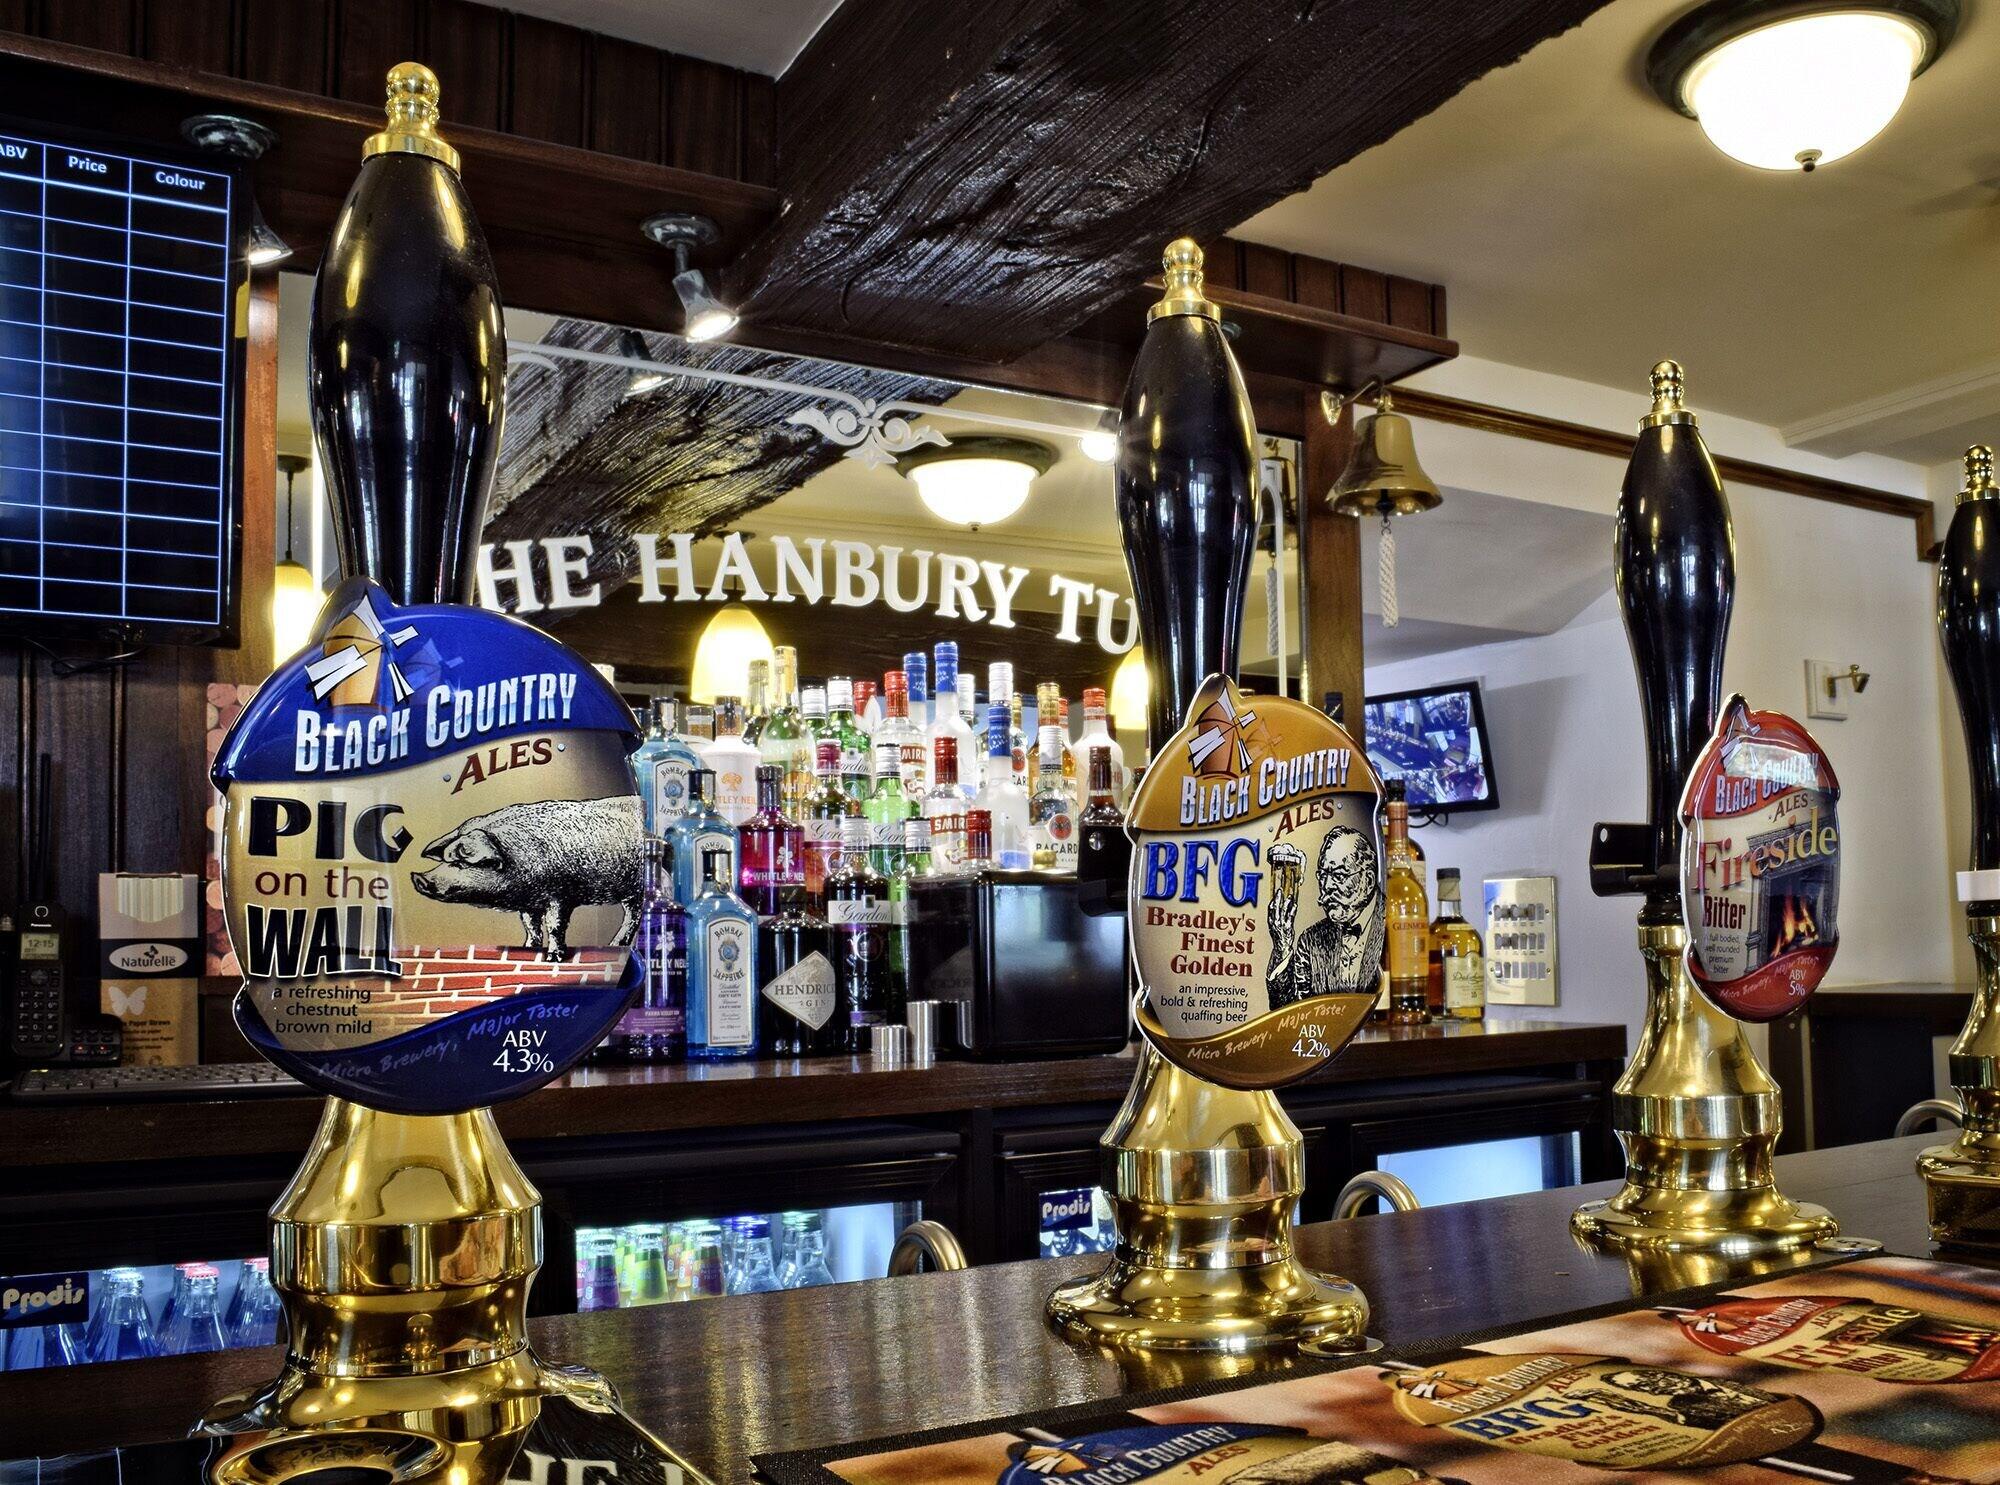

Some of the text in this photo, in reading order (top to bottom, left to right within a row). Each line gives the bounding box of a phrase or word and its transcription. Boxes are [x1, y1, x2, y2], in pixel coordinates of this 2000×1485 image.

[68, 155, 107, 174] Price
[155, 171, 206, 191] Colour
[632, 530, 1030, 629] HANBURY
[294, 672, 579, 774] BLACK COUNTRY
[450, 737, 553, 795] ALES
[661, 767, 688, 779] BOMBAY
[1179, 748, 1352, 827] BLACK COUNTRY
[1715, 752, 1819, 815] BLACK COUNTRY
[1273, 799, 1336, 842] ALES
[1772, 792, 1808, 823] ALES
[247, 796, 414, 863] PIG
[1692, 806, 1838, 892] Fireside
[255, 865, 390, 900] on the
[1142, 838, 1264, 908] BFG
[1146, 906, 1257, 936] Bradley's
[1702, 895, 1746, 930] Bitter
[246, 904, 403, 979] WALL
[714, 926, 744, 939] BOMBAY
[1180, 932, 1255, 955] Finest
[121, 955, 176, 967] Naturelle
[1170, 954, 1253, 977] Golden
[713, 968, 746, 982] SAPPHIRE
[1789, 969, 1807, 981] ABV
[273, 983, 372, 1003] a refreshing
[1178, 983, 1249, 998] an impressive,
[1789, 981, 1806, 997] 5%
[286, 1002, 359, 1018] chestnut
[1160, 995, 1248, 1012] bold & refreshing
[275, 1019, 372, 1035] brown mild
[466, 1010, 522, 1041] Major
[526, 1002, 580, 1022] Taste!
[1181, 1010, 1248, 1025] quaffing beer
[502, 1030, 548, 1048] ABV
[1186, 1004, 1347, 1060] Micro Brewery, Major Taste!
[1298, 1024, 1327, 1038] ABV
[492, 1048, 555, 1073] 4.3%
[1292, 1038, 1331, 1058] 4.2%
[1042, 1194, 1091, 1221] Prodis
[2, 1278, 85, 1314] Prodis
[1546, 1369, 1592, 1394] ALES
[1449, 1397, 1603, 1440] BFG
[1125, 1425, 1238, 1469] COUNTRY
[1187, 1444, 1251, 1477] ALES
